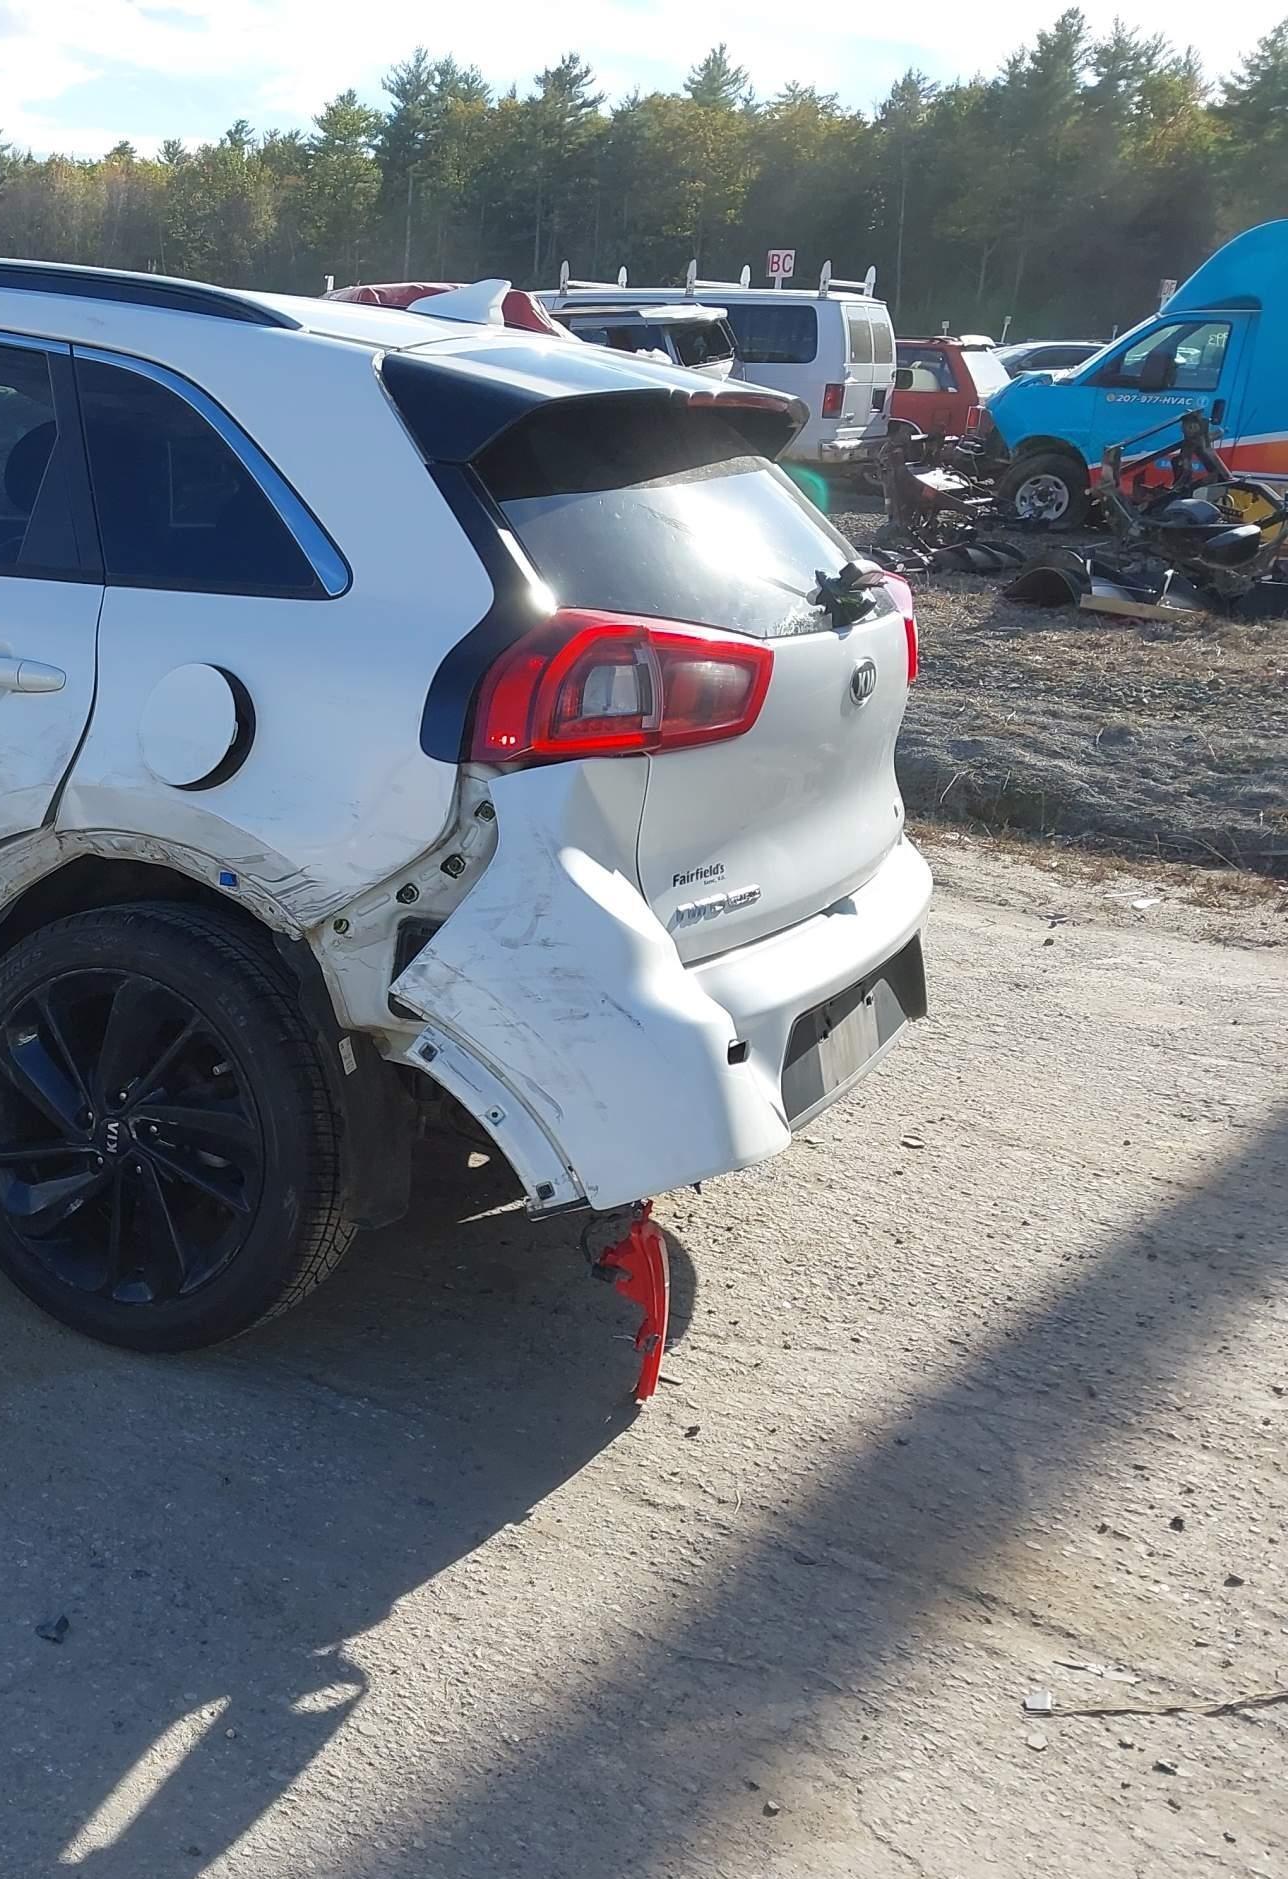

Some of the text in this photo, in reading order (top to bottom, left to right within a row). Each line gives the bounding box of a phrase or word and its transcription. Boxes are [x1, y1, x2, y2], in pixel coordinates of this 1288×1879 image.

[770, 253, 793, 273] BC
[1115, 394, 1193, 406] 207-977-HVAC
[856, 669, 875, 697] KIA
[672, 863, 725, 888] Fairfield's
[106, 1122, 120, 1153] KIA
